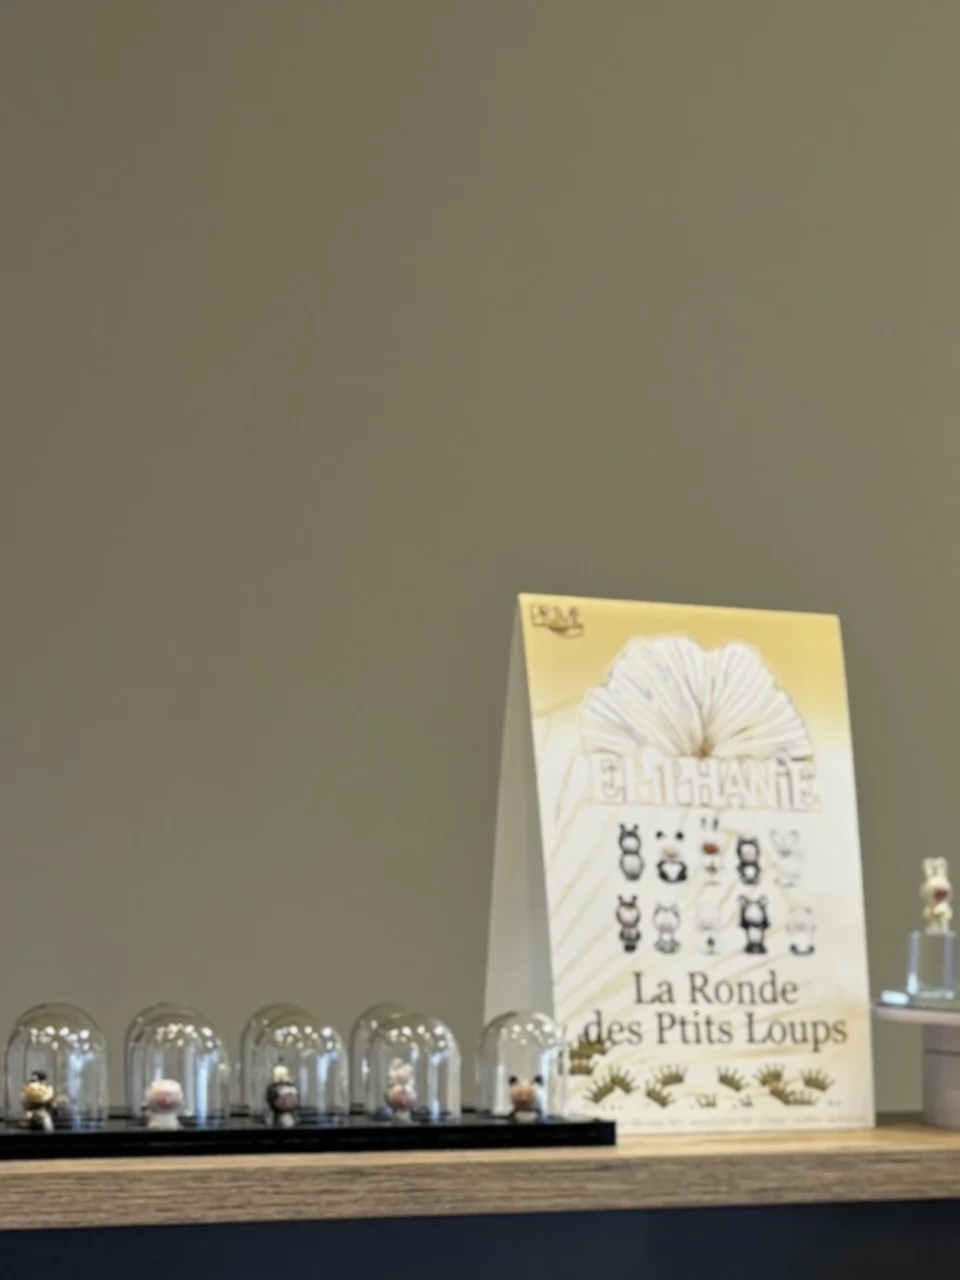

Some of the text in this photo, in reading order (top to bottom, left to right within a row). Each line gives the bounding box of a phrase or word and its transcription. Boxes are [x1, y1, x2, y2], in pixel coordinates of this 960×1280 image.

[633, 969, 799, 1005] La Ronde
[583, 1009, 848, 1053] des Ptits Loups
